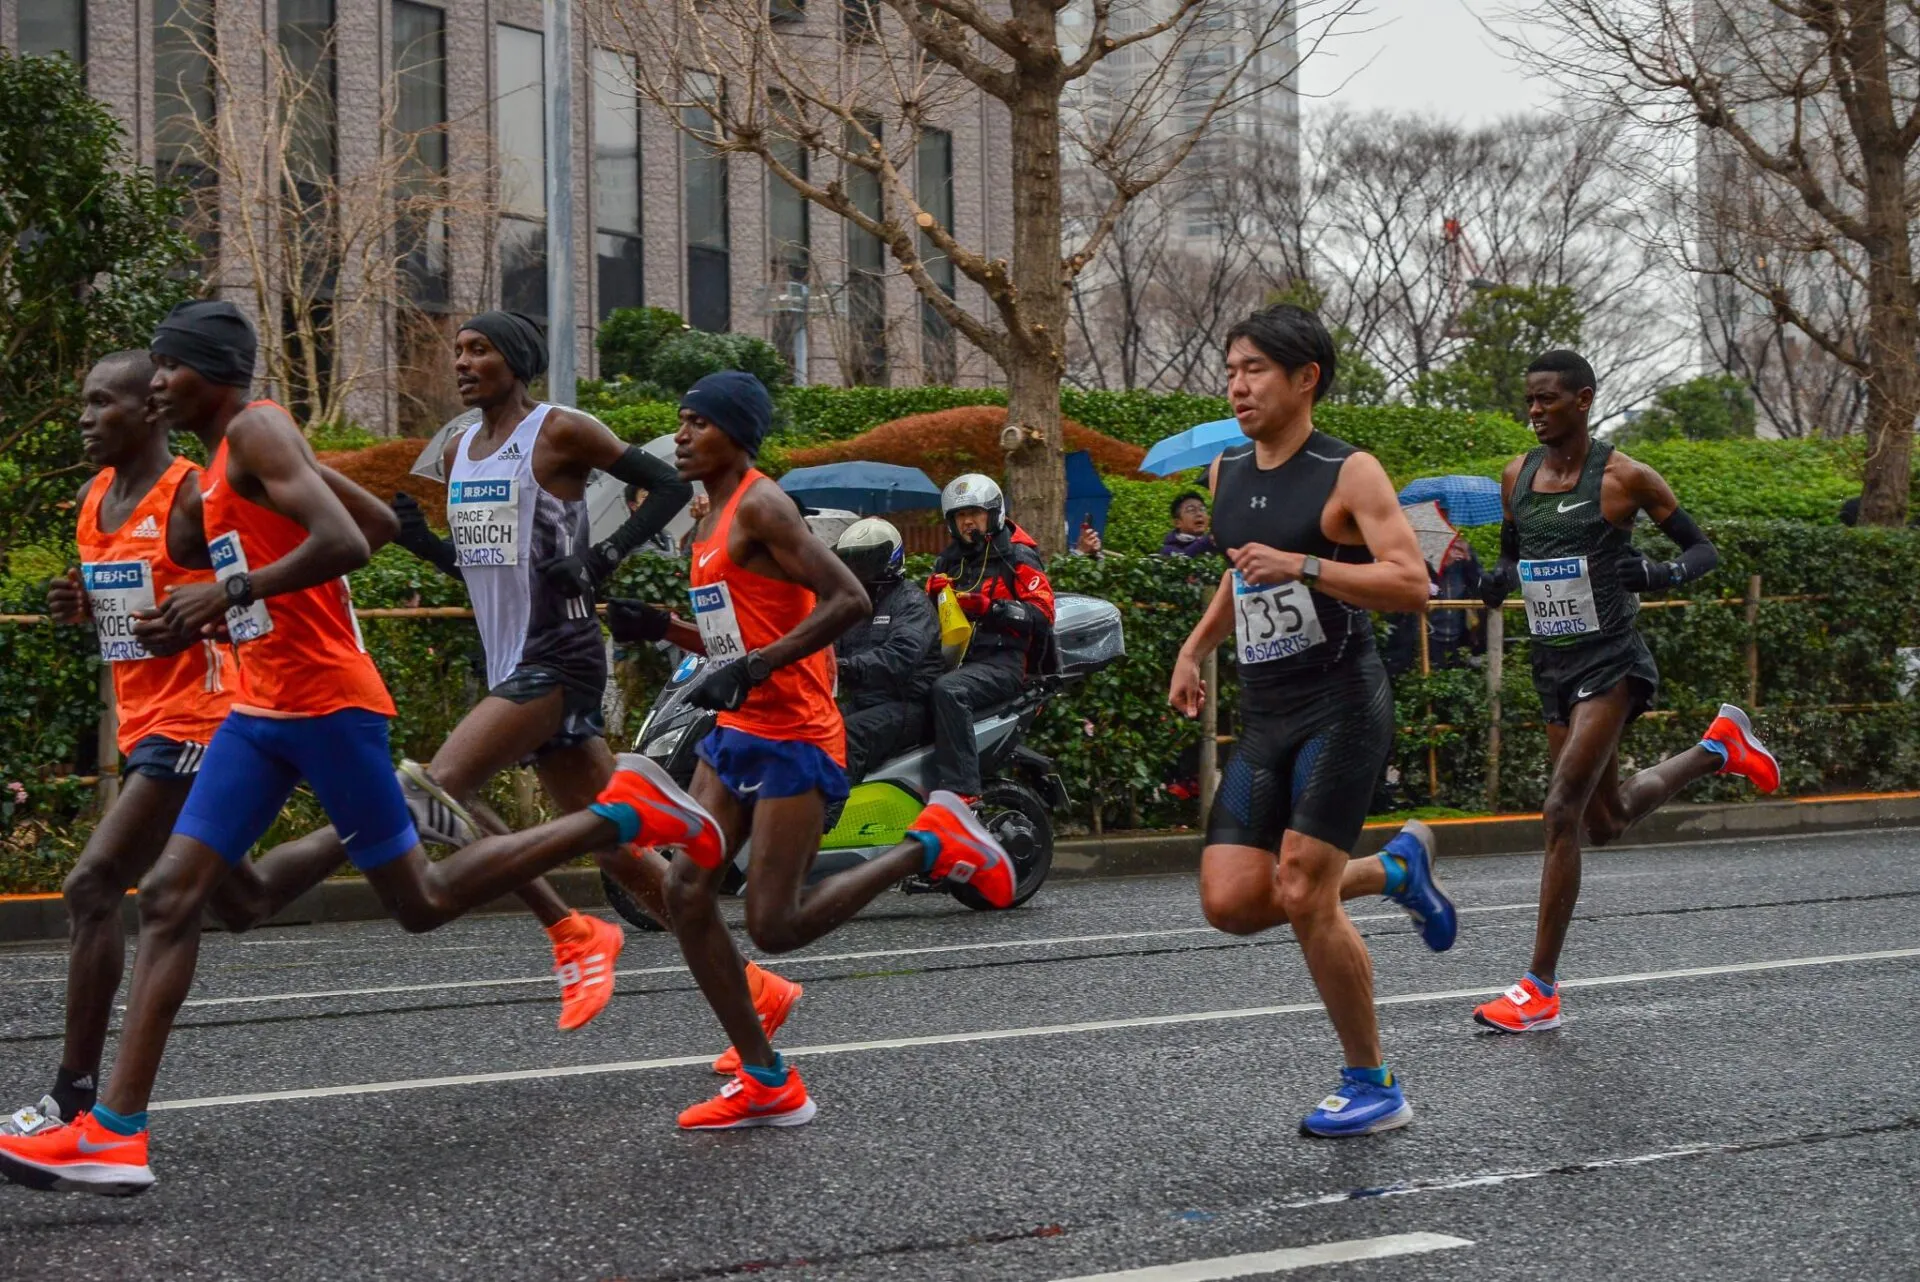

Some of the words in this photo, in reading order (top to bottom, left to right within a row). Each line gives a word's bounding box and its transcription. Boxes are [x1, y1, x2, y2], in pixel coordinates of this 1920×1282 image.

[498, 453, 523, 461] adidas
[463, 485, 506, 498] 東京メトロ
[457, 510, 484, 523] PACE
[488, 509, 494, 522] 2
[94, 569, 138, 583] 東京メトロ
[1533, 563, 1576, 577] 東京メトロ
[1544, 584, 1552, 598] 9
[1240, 587, 1303, 642] 135
[1532, 598, 1579, 618] ABATE
[97, 615, 137, 637] KOEC
